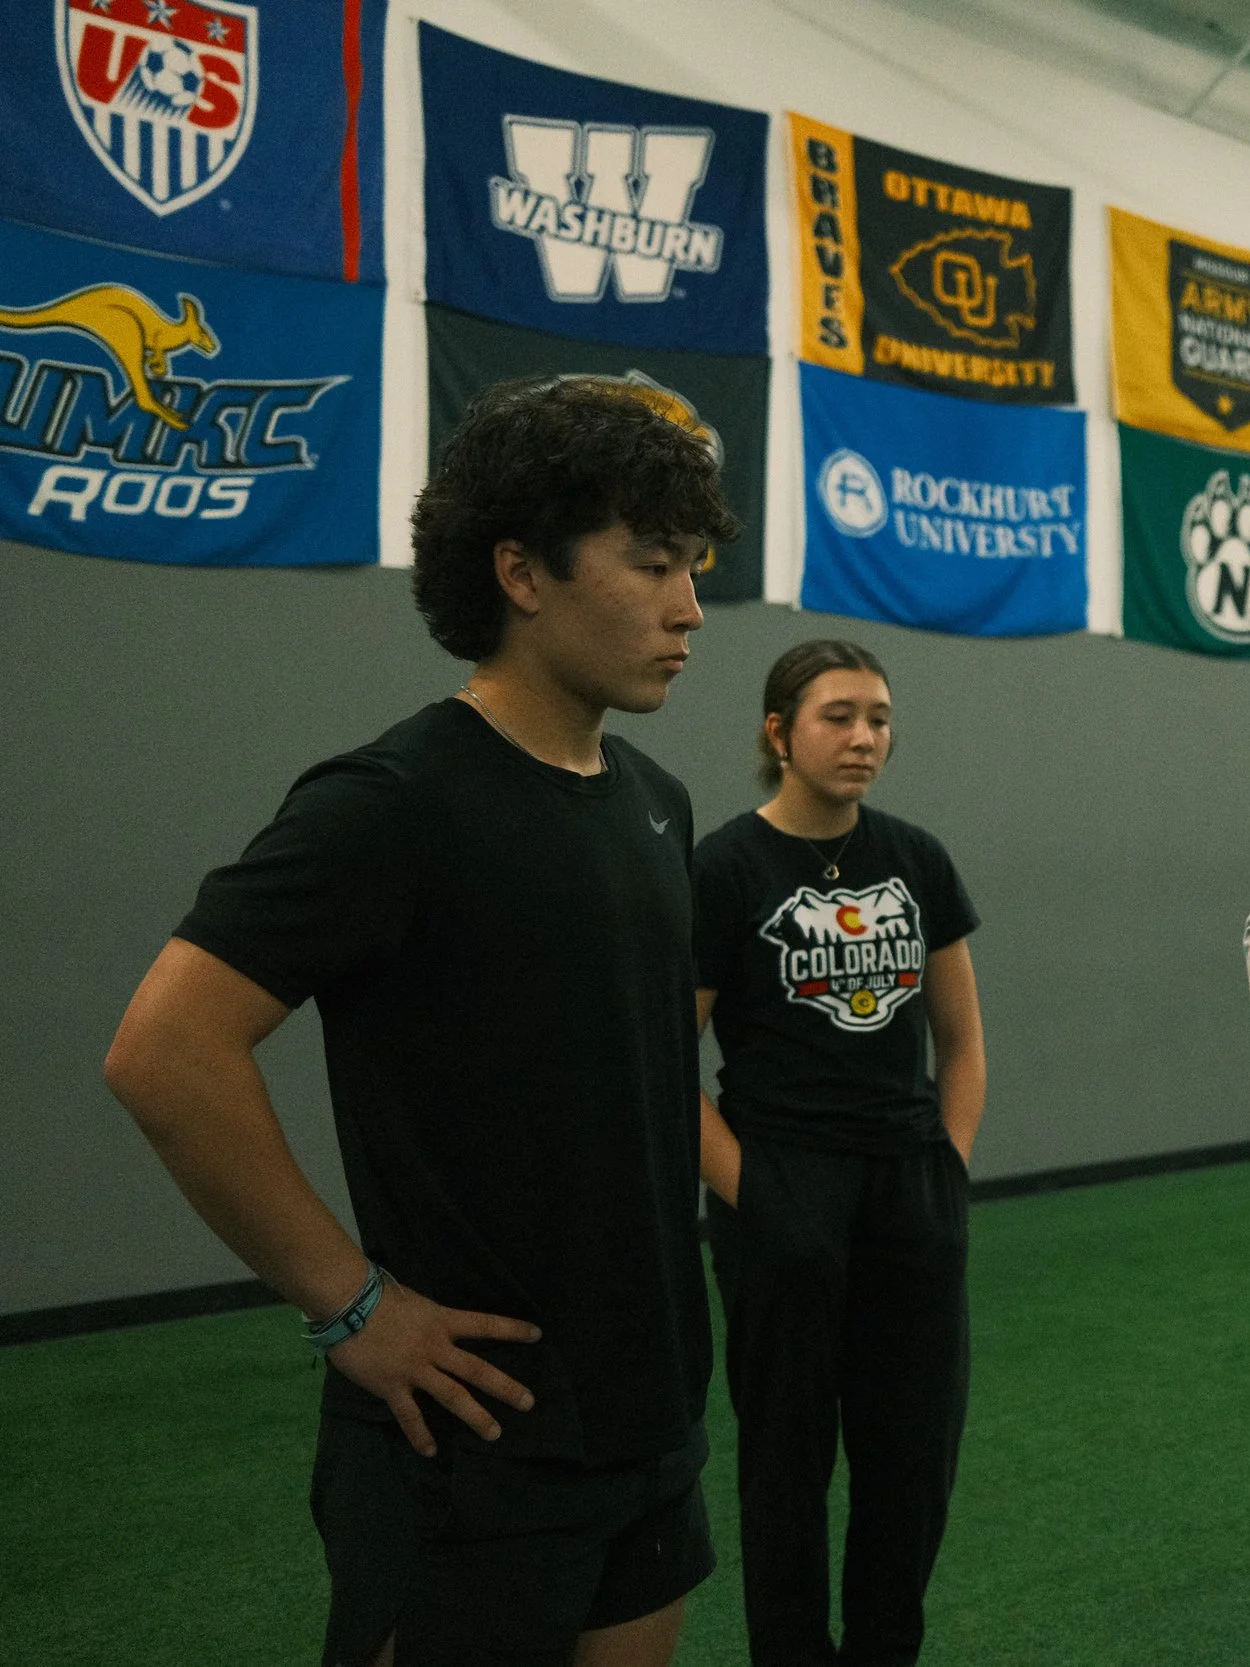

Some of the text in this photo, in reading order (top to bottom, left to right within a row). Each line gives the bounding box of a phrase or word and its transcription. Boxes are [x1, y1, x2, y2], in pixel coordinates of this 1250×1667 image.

[497, 182, 719, 266] WASHBURN
[882, 169, 1033, 231] OTTAWA
[27, 464, 255, 522] ROOS
[1213, 562, 1250, 618] N
[791, 939, 922, 982] COLORADO
[866, 973, 896, 989] JULY
